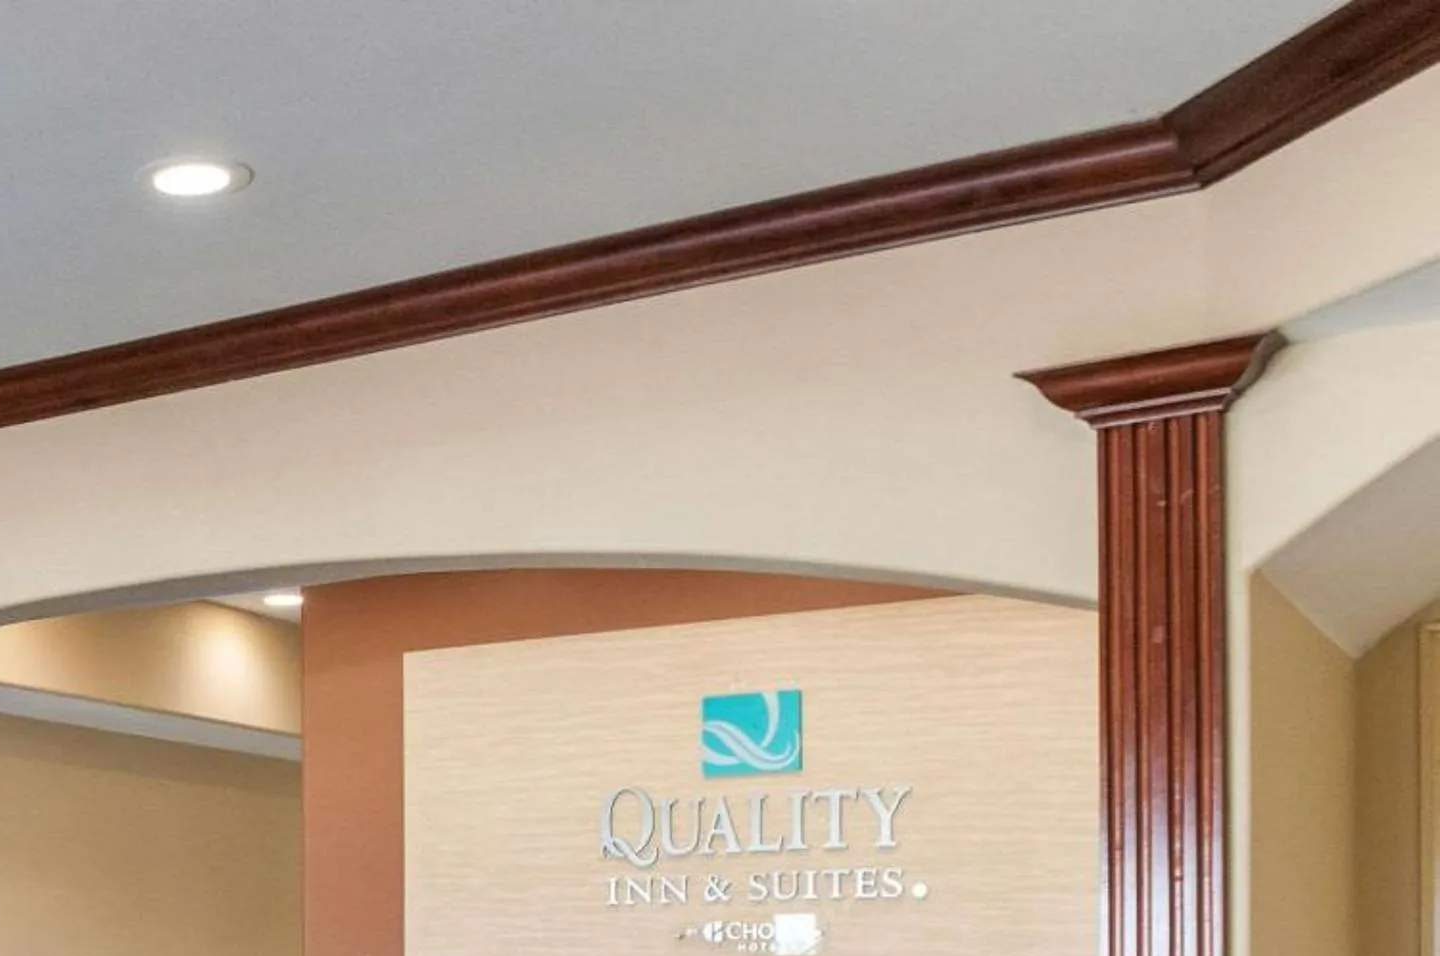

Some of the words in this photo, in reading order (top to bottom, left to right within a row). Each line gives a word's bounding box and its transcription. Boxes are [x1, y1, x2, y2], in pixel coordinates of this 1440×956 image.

[601, 786, 912, 867] QUALITY
[608, 876, 689, 906] INN
[704, 875, 731, 902] &
